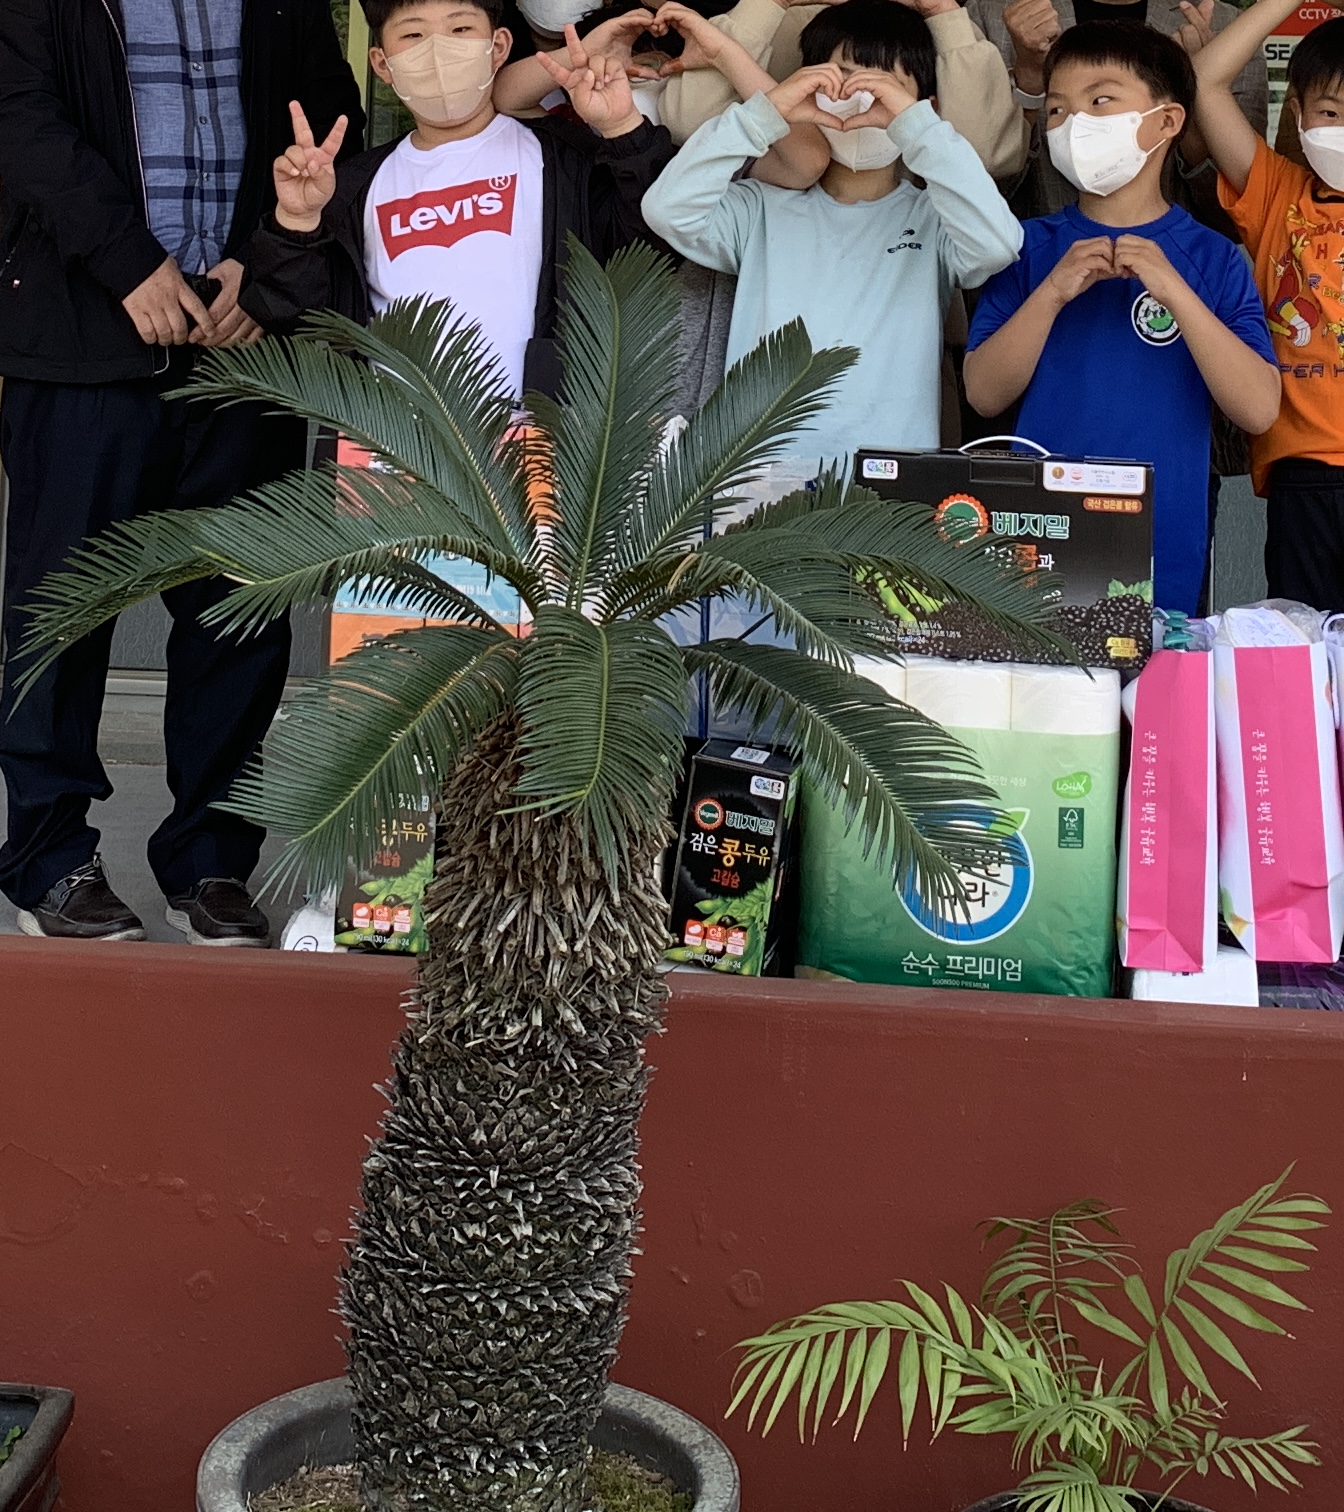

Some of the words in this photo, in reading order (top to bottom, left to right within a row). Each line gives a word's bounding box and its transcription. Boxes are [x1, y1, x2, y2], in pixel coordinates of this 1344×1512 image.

[1299, 8, 1329, 20] CCTV
[1264, 43, 1296, 61] SE
[990, 511, 1071, 539] 베지밀
[1144, 730, 1157, 740] 큰
[1252, 729, 1266, 740] 큰
[1142, 745, 1157, 764] 꿈을
[1251, 743, 1268, 763] 꿈을
[1142, 768, 1156, 797] 키우는
[1255, 766, 1269, 798] 키우는
[725, 810, 776, 836] 베지밀
[1140, 802, 1157, 824] 행복
[1256, 801, 1273, 823] 행복
[901, 951, 940, 976] 순수
[944, 954, 1022, 982] 프리미엄
